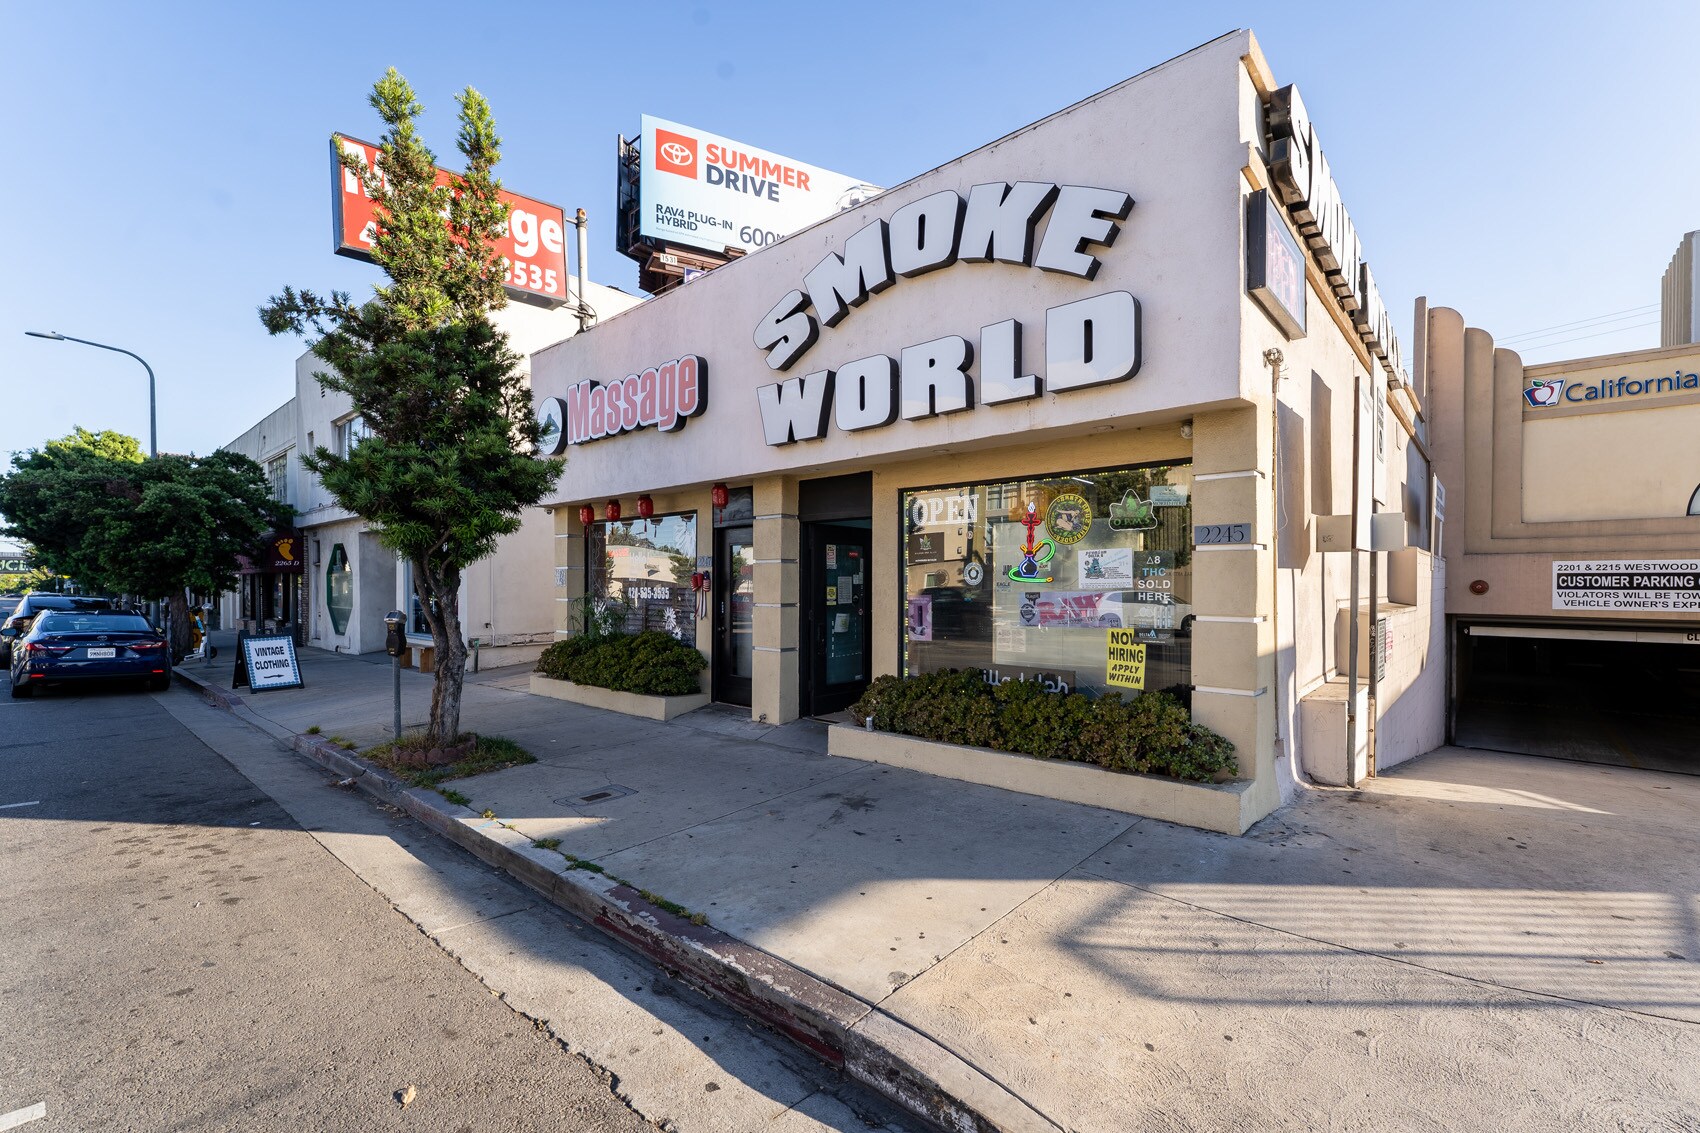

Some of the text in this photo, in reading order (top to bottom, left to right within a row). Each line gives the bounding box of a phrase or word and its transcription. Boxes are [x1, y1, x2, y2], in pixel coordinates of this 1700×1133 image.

[705, 143, 811, 192] SUMMER
[706, 164, 780, 203] DRIVE
[656, 203, 733, 231] RAV4 PLUG-IN
[656, 213, 698, 232] HYBRID
[661, 254, 677, 264] 1531
[753, 181, 1133, 371] SMOKE
[757, 290, 1140, 446] WORLD
[1565, 370, 1698, 402] California
[567, 354, 700, 445] Massage
[912, 494, 979, 526] OPEN
[1200, 525, 1245, 544] 2245
[1142, 567, 1167, 577] THC
[1595, 563, 1621, 571] 2215
[1624, 563, 1698, 571] WESTWOOD
[1138, 580, 1171, 589] SOLD
[1559, 576, 1630, 587] CUSTOMER
[1633, 575, 1695, 587] PARKING
[1138, 592, 1171, 601] HERE
[1557, 591, 1620, 599] VIOLATORS
[1623, 591, 1651, 599] WILL
[1614, 600, 1669, 608] OWNER'S
[254, 646, 285, 657] VINTAGE
[1108, 646, 1144, 664] HIRING
[254, 658, 290, 670] CLOTHING
[1112, 663, 1140, 674] APPLY
[1108, 672, 1142, 685] WITHIN
